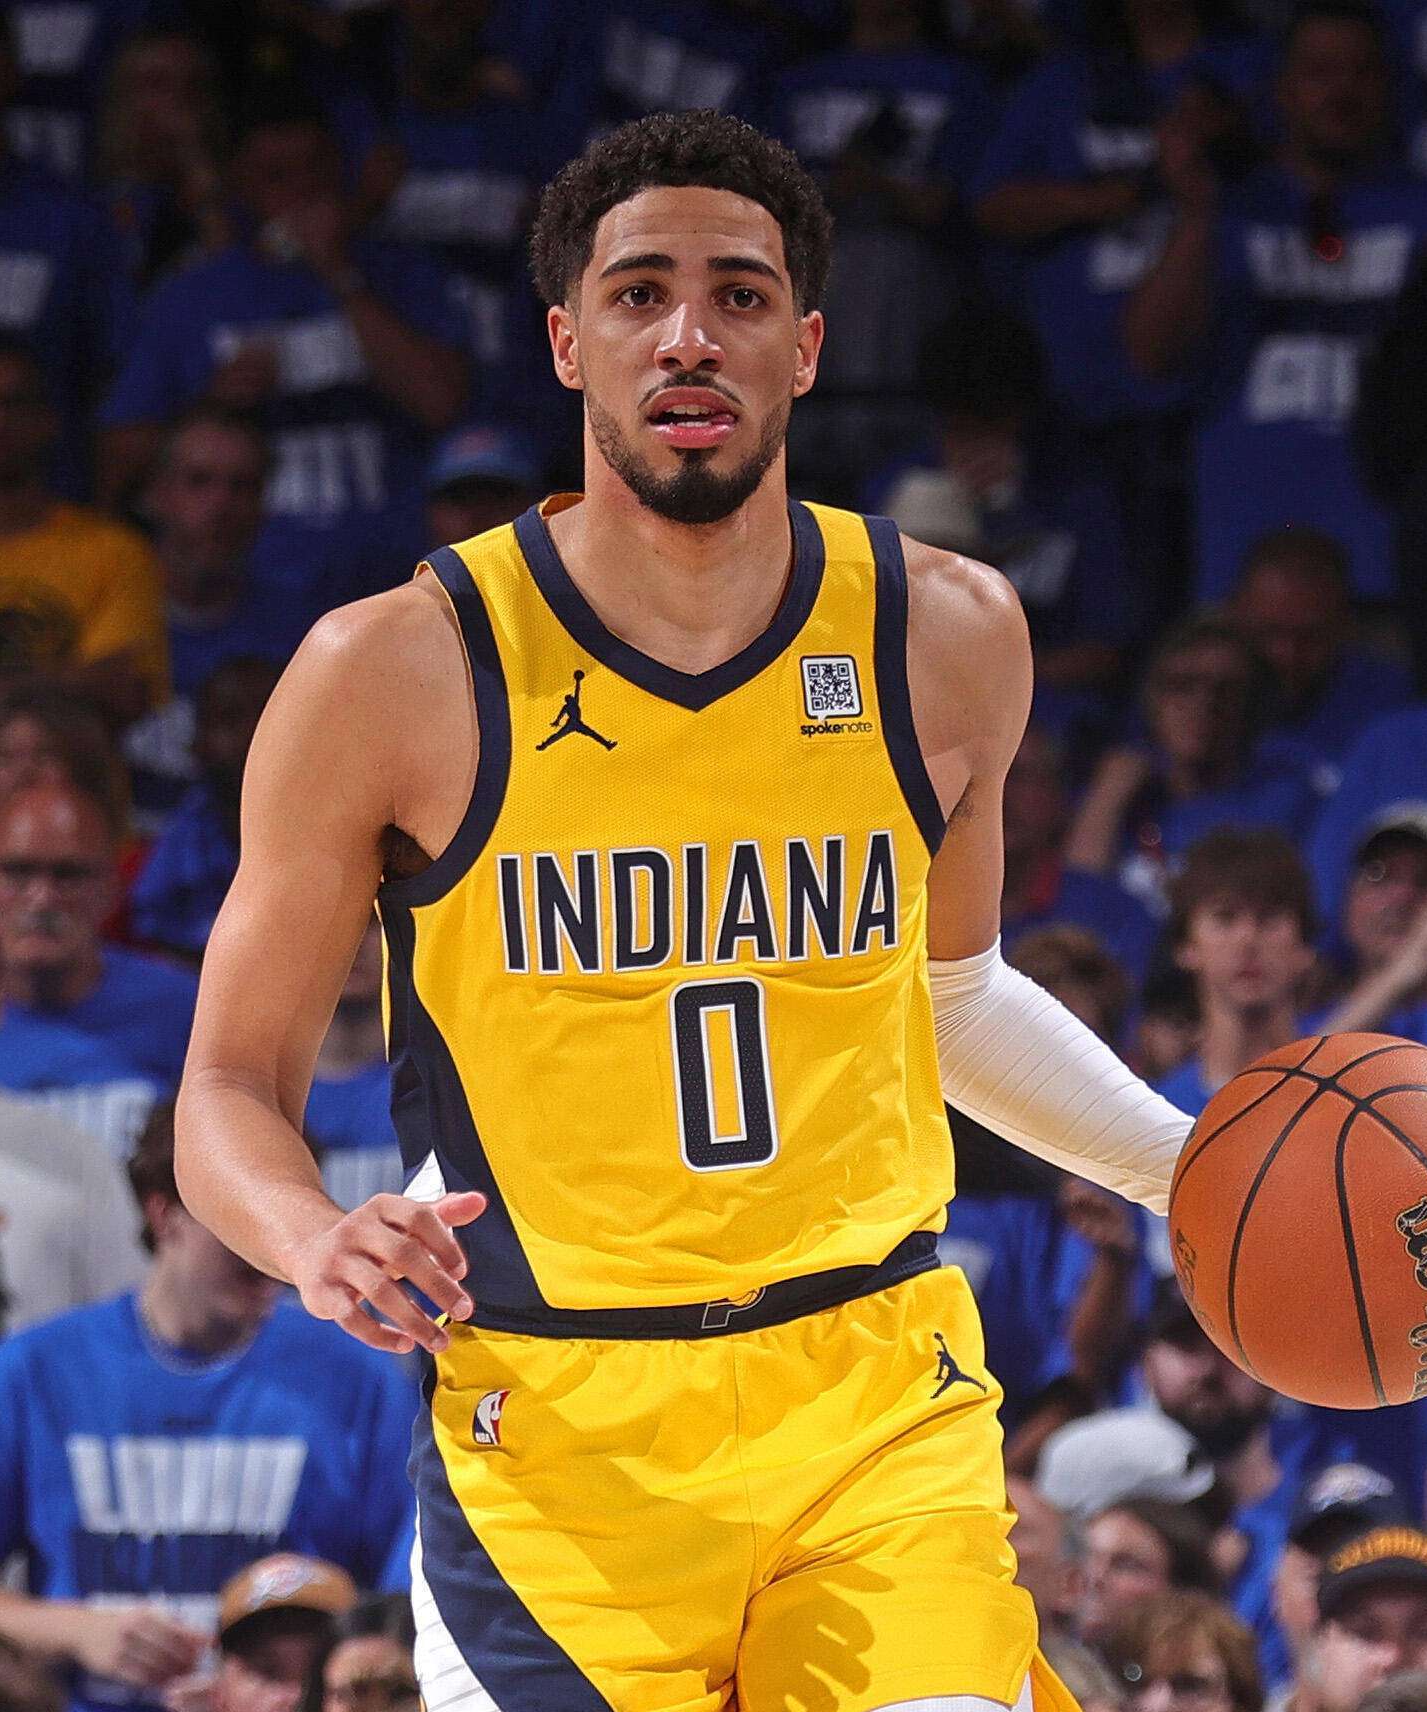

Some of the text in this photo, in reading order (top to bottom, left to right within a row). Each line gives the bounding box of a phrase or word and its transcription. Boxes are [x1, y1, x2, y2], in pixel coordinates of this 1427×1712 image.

[801, 721, 872, 738] spokenote
[497, 830, 899, 975] INDIANA
[668, 976, 780, 1172] 0
